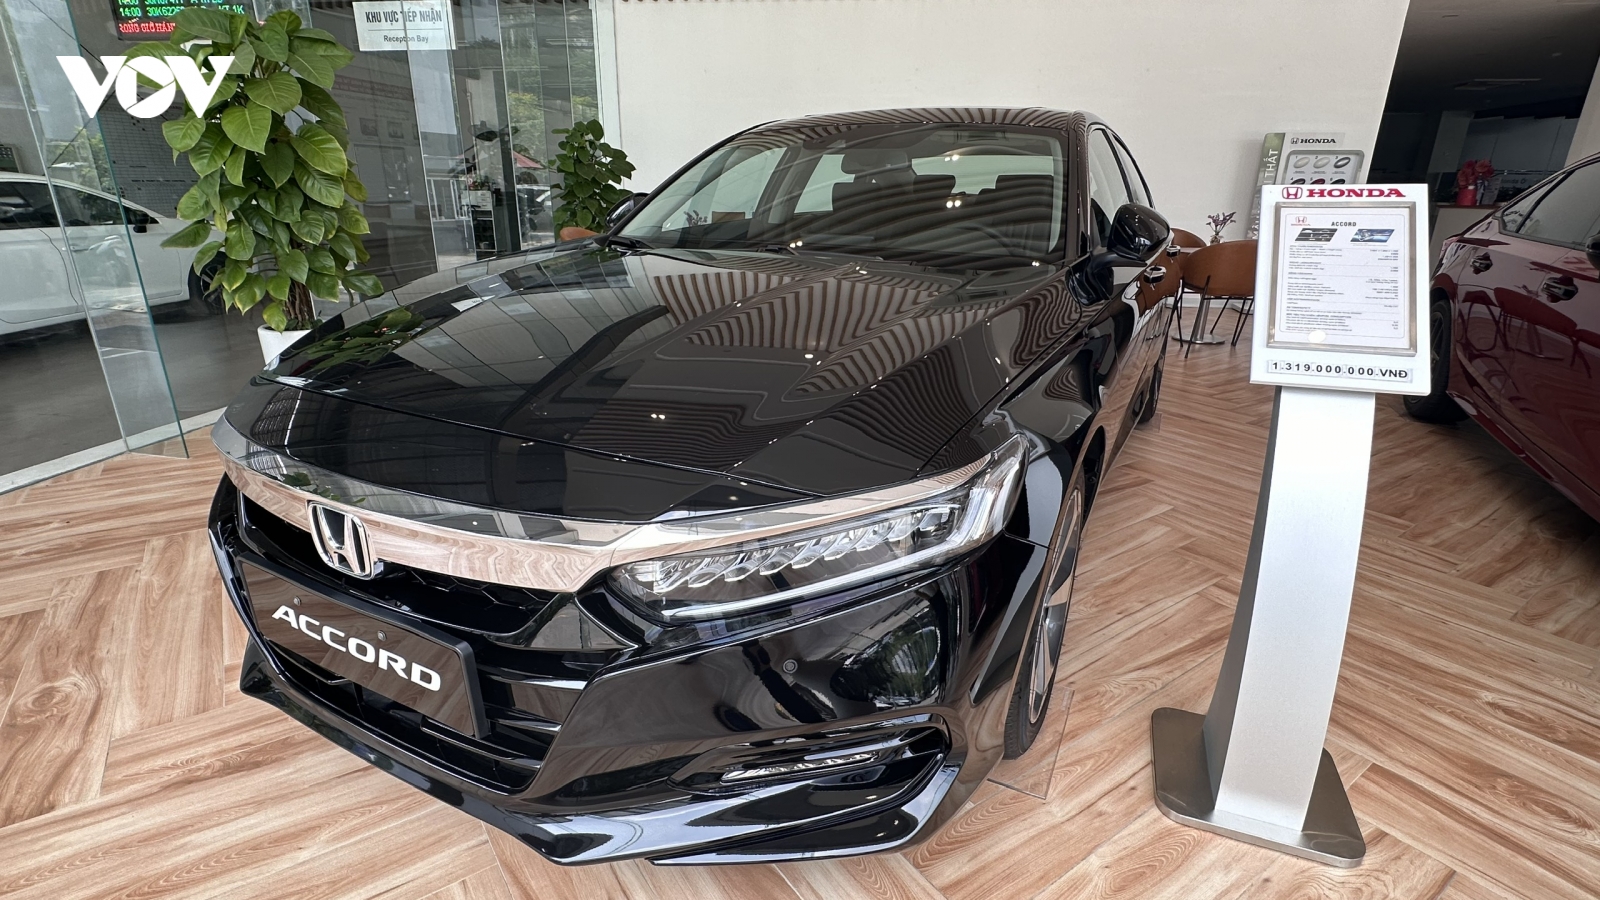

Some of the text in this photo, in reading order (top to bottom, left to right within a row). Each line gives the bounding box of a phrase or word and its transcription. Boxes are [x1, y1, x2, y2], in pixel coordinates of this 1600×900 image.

[119, 7, 141, 17] 14:00
[365, 11, 382, 23] KHU
[383, 10, 399, 26] VỰC
[419, 8, 442, 25] NHẬN
[383, 35, 429, 43] Recepton Bay
[1306, 188, 1406, 198] HONDA
[272, 605, 441, 692] ACCORD
